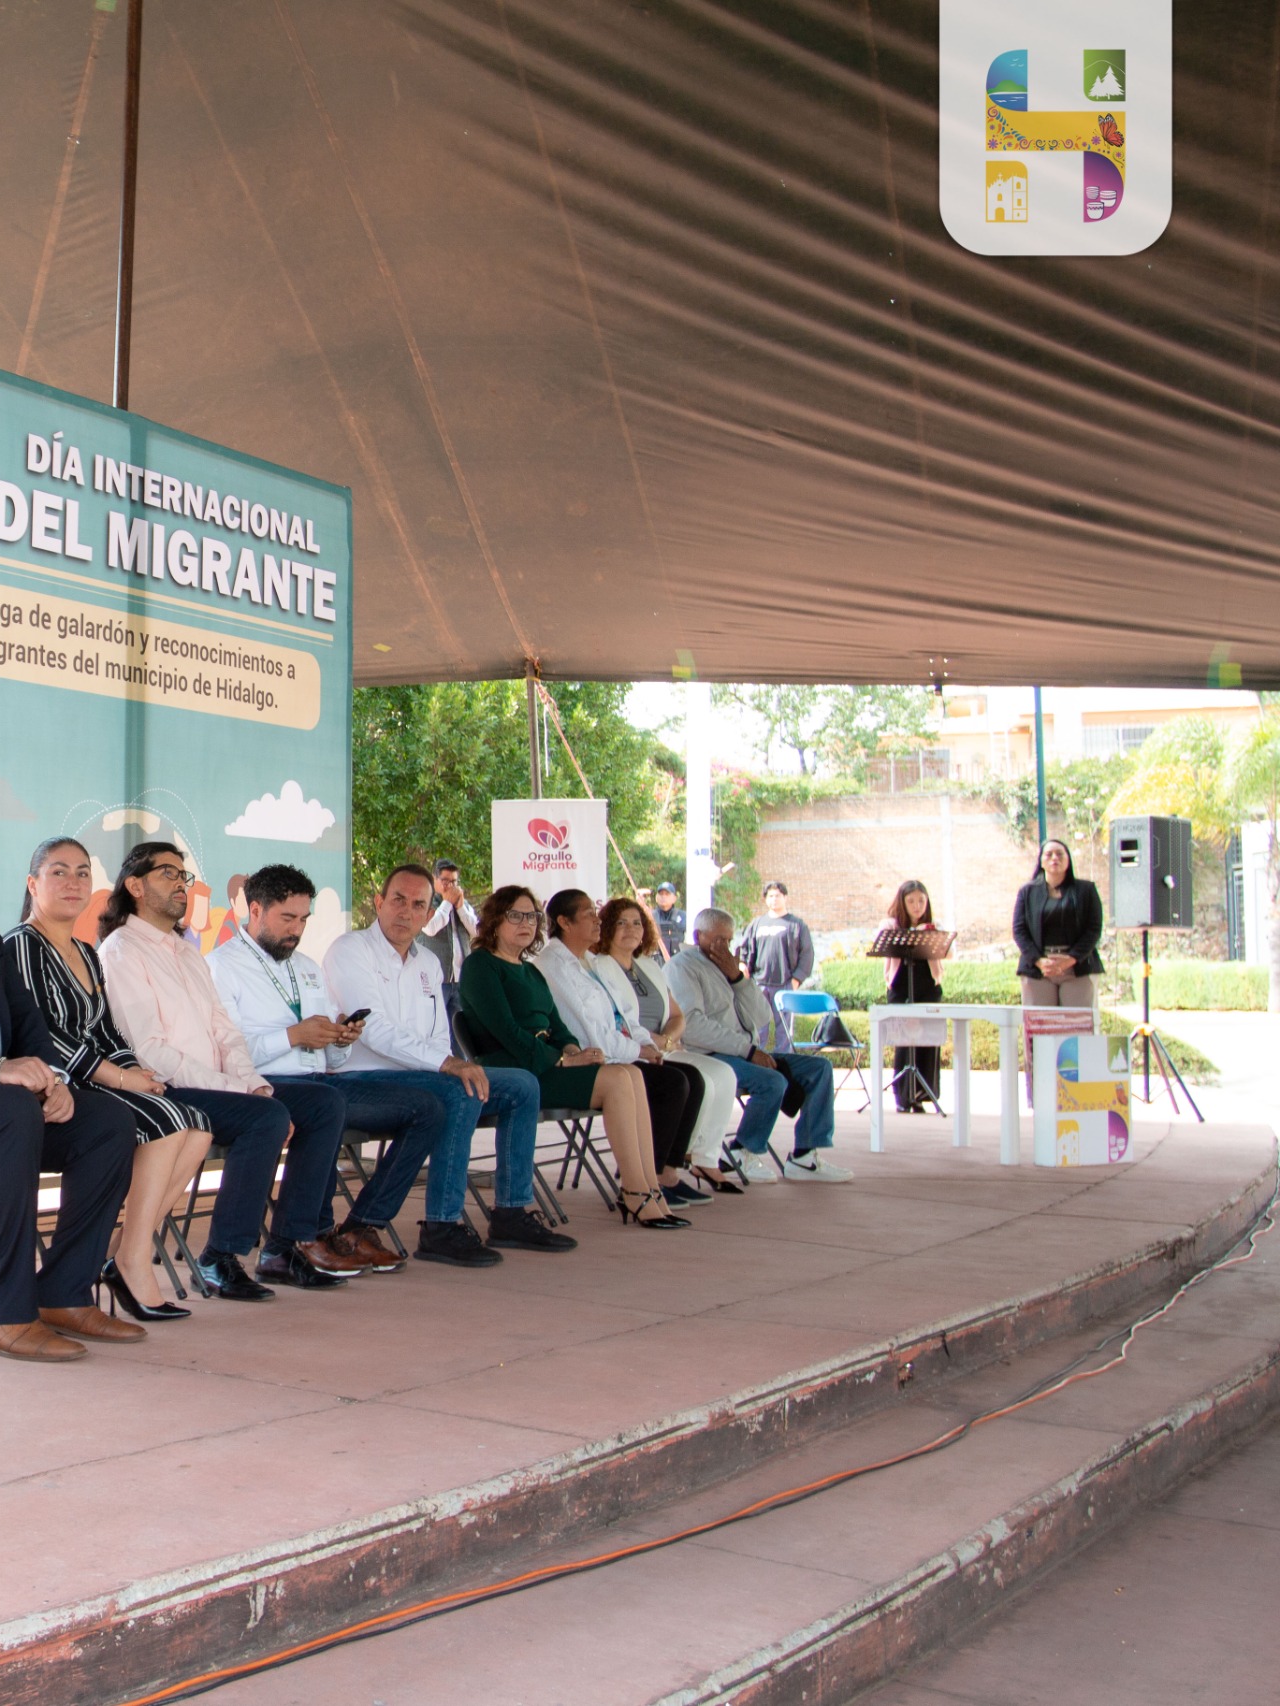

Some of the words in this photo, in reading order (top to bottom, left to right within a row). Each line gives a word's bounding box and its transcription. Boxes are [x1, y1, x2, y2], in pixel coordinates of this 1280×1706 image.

[27, 431, 85, 486] DÍA
[94, 454, 320, 554] INTERNACIONAL
[108, 511, 337, 622] MIGRANTE
[29, 603, 52, 630] de
[57, 612, 135, 648] galardón
[140, 631, 150, 655] y
[154, 634, 283, 677] reconocimientos
[287, 662, 296, 680] a
[73, 649, 99, 676] del
[105, 660, 188, 695] municipio
[193, 672, 212, 697] de
[216, 677, 279, 712] Hidalgo.
[523, 861, 577, 872] Migrante
[528, 850, 573, 863] Orgullo
